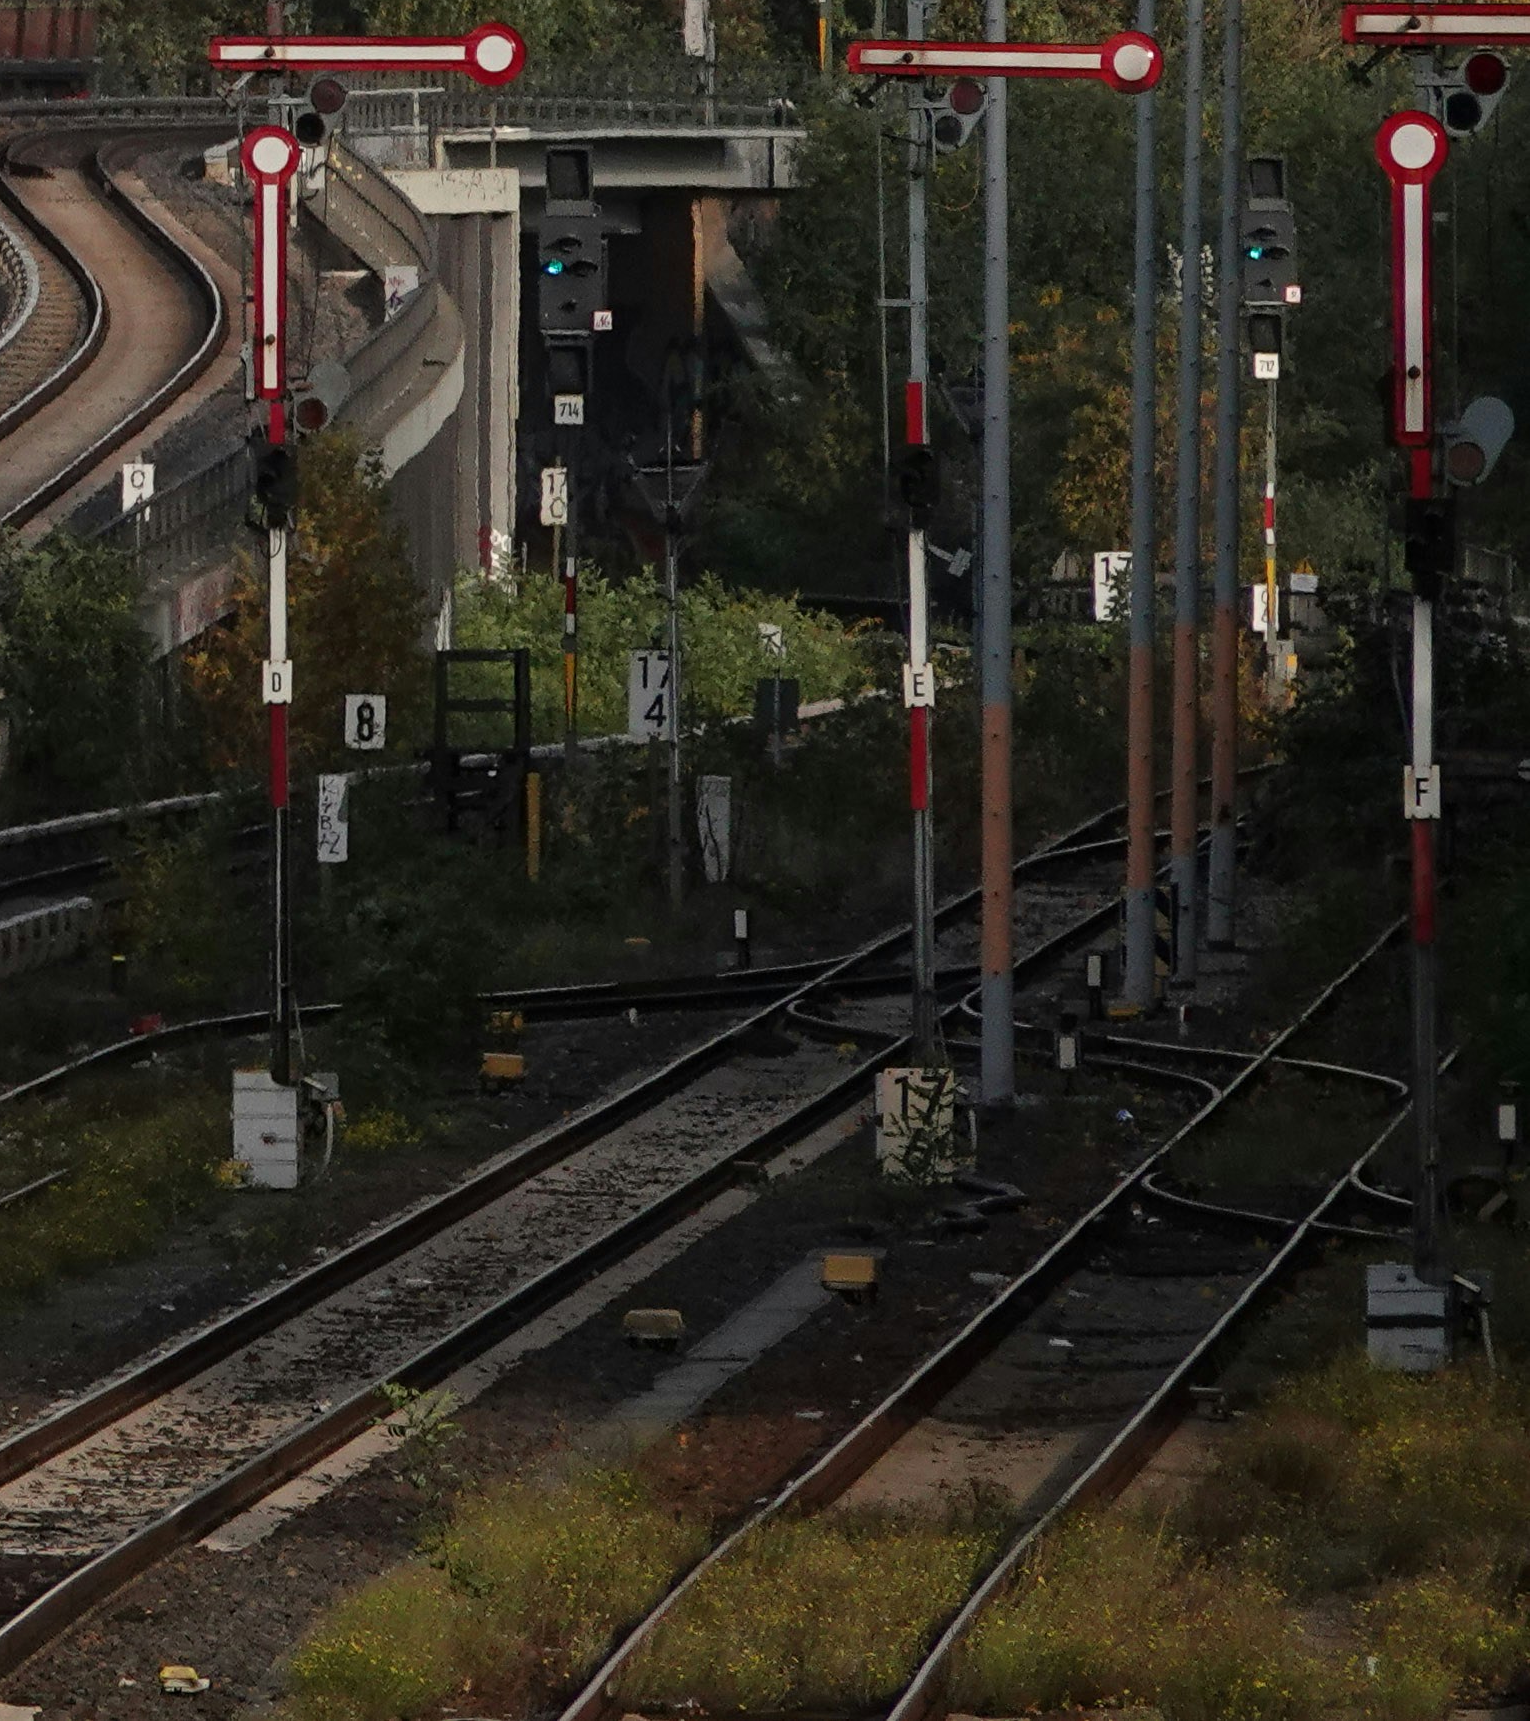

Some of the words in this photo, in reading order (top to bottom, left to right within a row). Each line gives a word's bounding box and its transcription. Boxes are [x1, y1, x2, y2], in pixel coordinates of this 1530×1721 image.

[559, 401, 580, 418] 714
[271, 672, 282, 693] D
[913, 672, 925, 697] E
[356, 700, 375, 742] 8
[644, 693, 667, 728] 4
[1415, 777, 1429, 807] F
